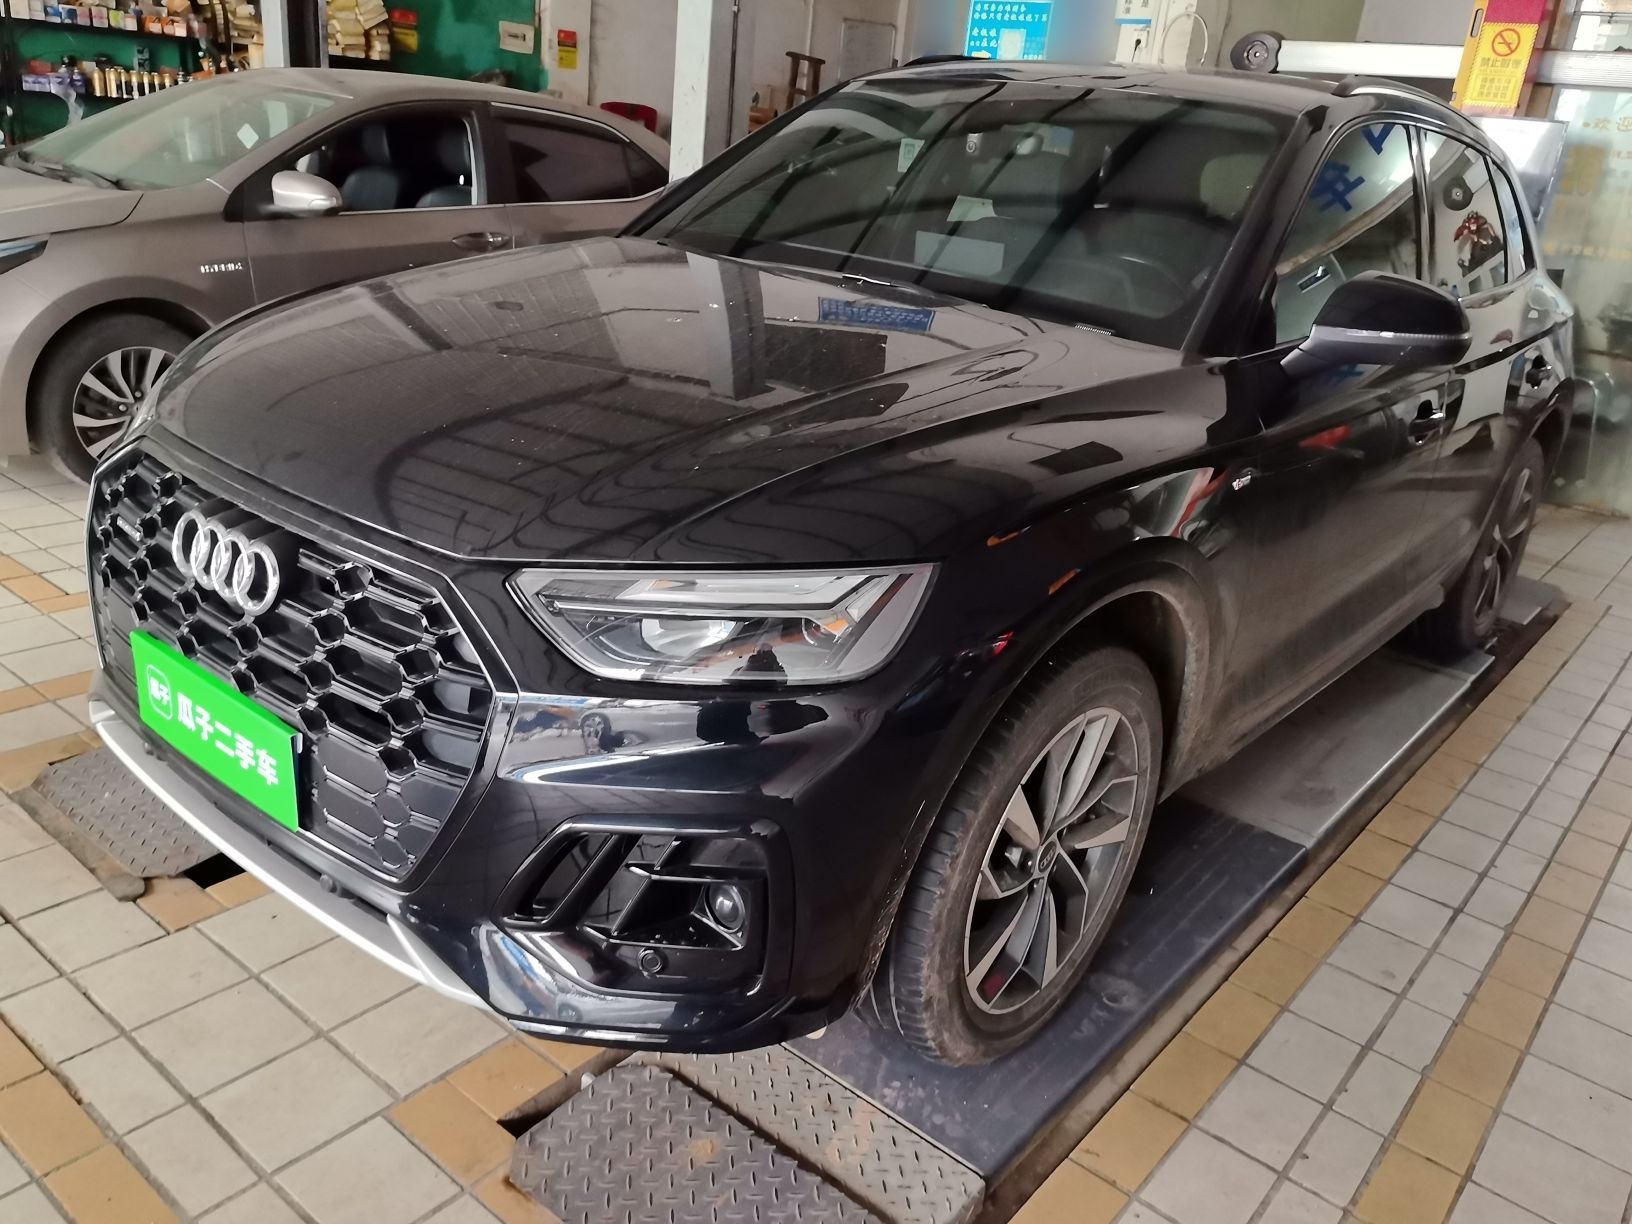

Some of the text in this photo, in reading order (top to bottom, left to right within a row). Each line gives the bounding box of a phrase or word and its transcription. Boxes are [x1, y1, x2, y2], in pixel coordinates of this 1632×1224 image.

[178, 692, 279, 785] 瓜子二手车
